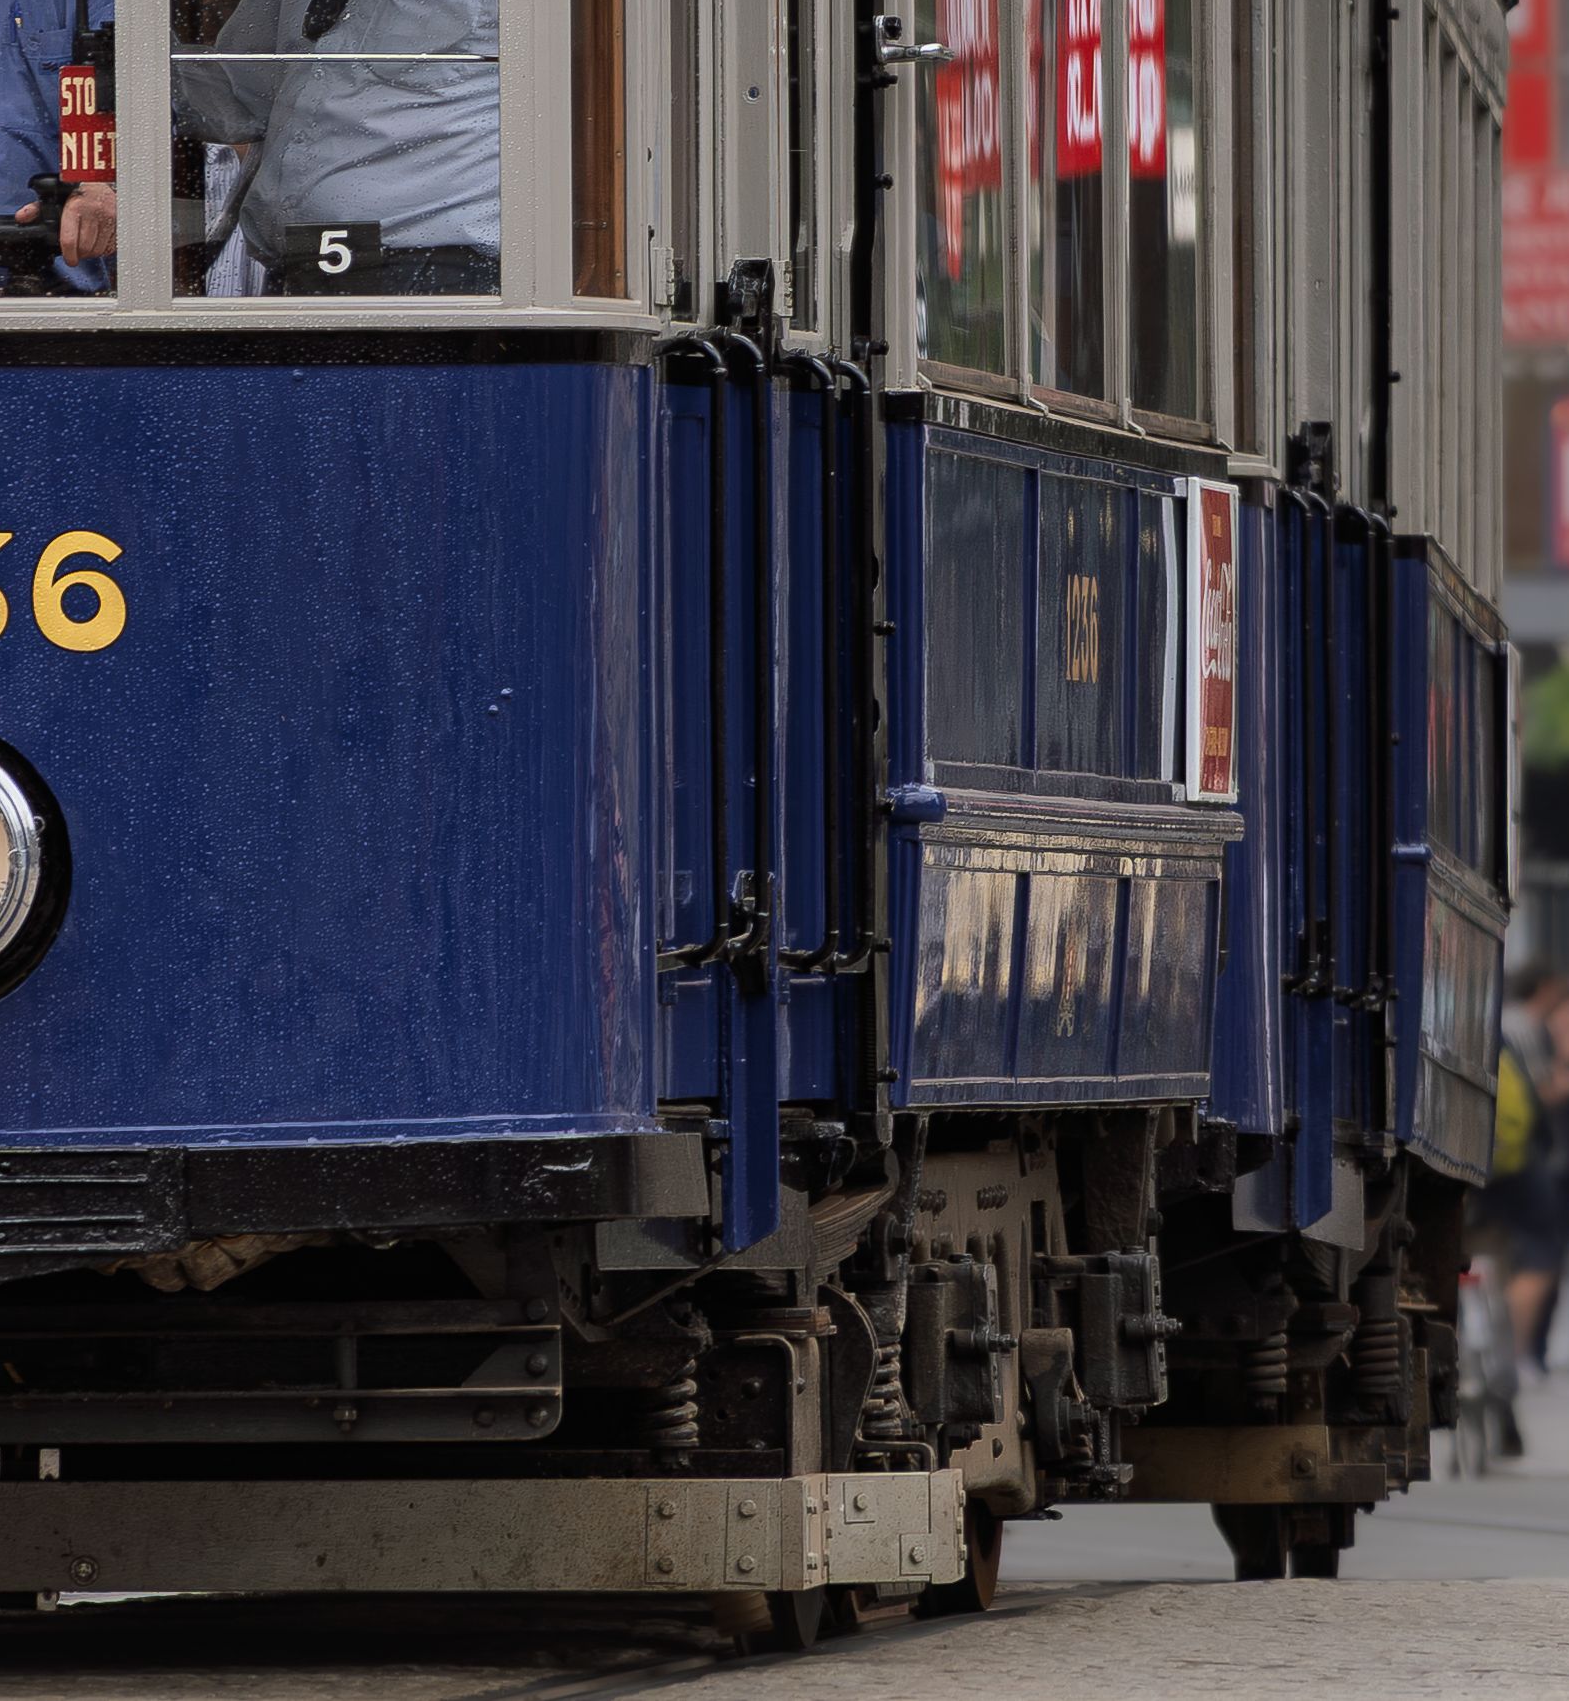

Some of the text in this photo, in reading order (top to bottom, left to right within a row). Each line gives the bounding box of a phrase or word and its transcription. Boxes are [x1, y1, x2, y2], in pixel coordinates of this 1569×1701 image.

[61, 77, 96, 115] STO
[317, 230, 352, 274] 5
[1065, 575, 1099, 684] 1236
